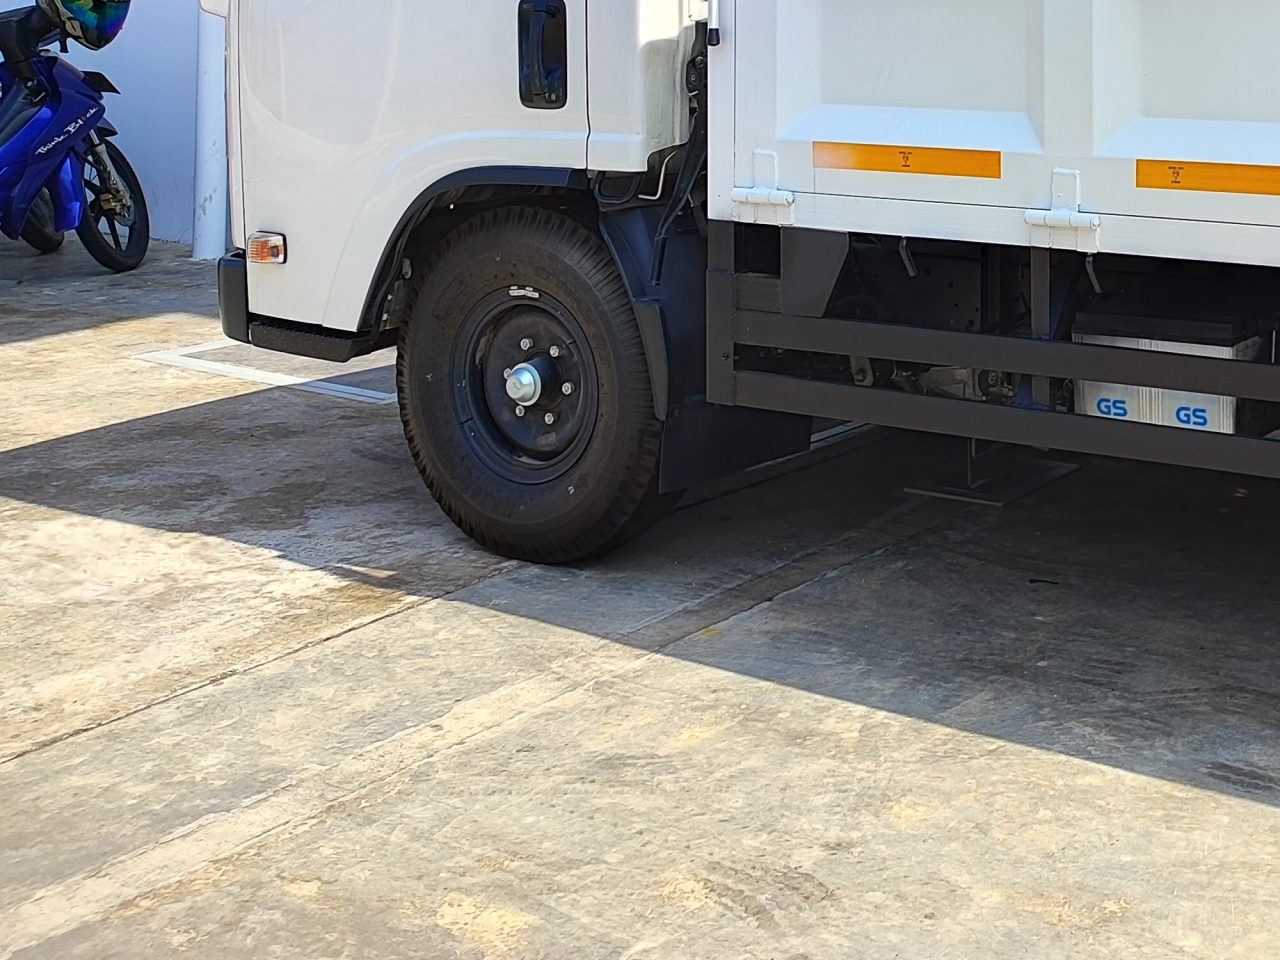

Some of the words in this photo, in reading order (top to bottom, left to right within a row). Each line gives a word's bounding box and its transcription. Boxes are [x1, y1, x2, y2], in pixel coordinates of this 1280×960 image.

[35, 134, 68, 155] Think
[1097, 398, 1128, 417] GS
[1175, 406, 1208, 426] GS
